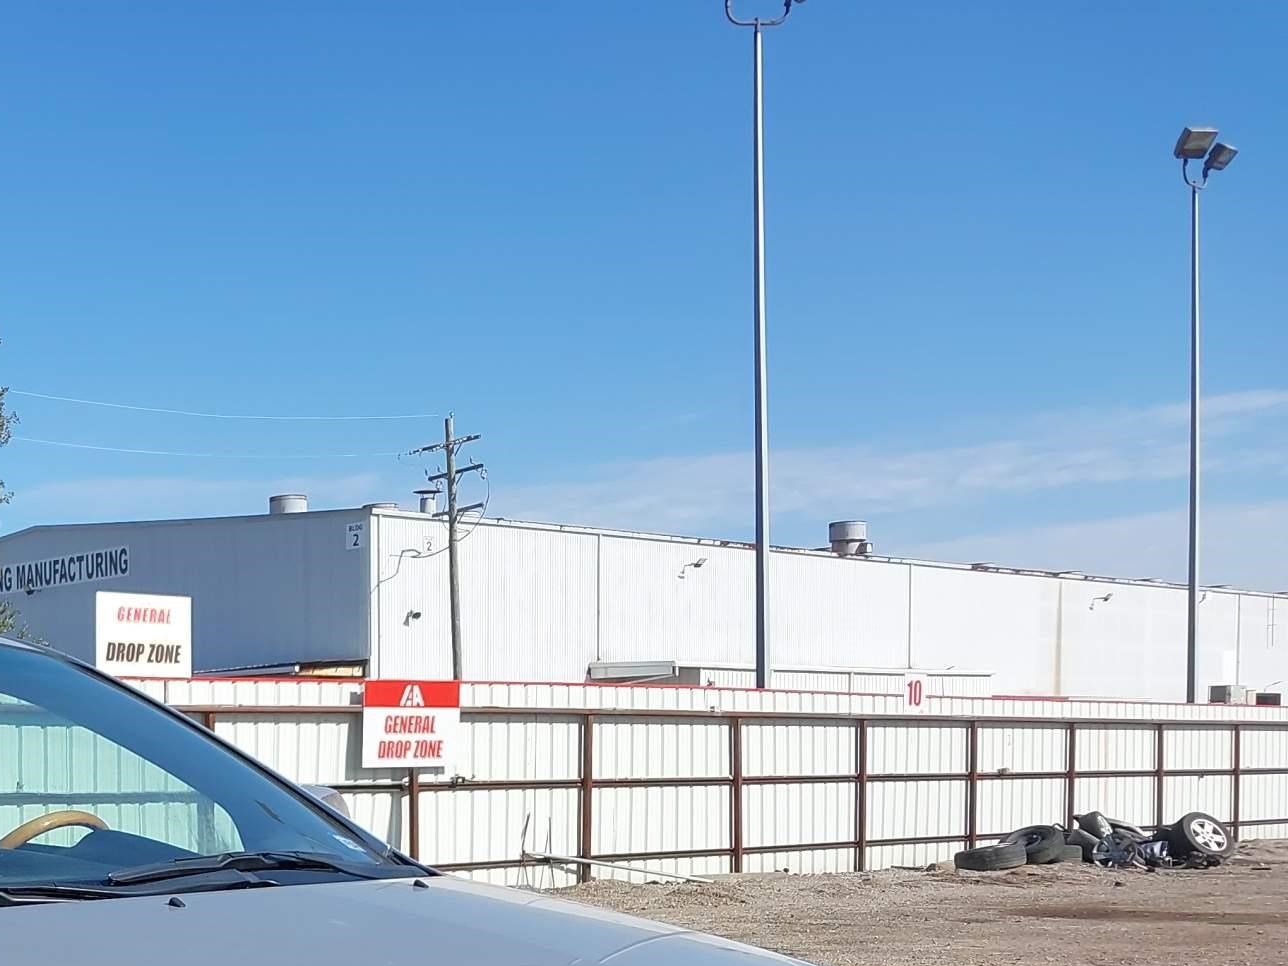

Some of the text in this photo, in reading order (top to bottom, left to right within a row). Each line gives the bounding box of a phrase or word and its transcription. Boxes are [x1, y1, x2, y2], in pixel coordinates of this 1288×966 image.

[352, 533, 360, 547] 2
[426, 541, 433, 552] 2
[16, 548, 128, 590] MANUFACTURING
[117, 606, 172, 625] GENERAL
[106, 642, 182, 664] DROP ZONE
[907, 680, 922, 706] 10
[384, 715, 436, 735] GENERAL
[377, 740, 444, 759] DROP ZONE
